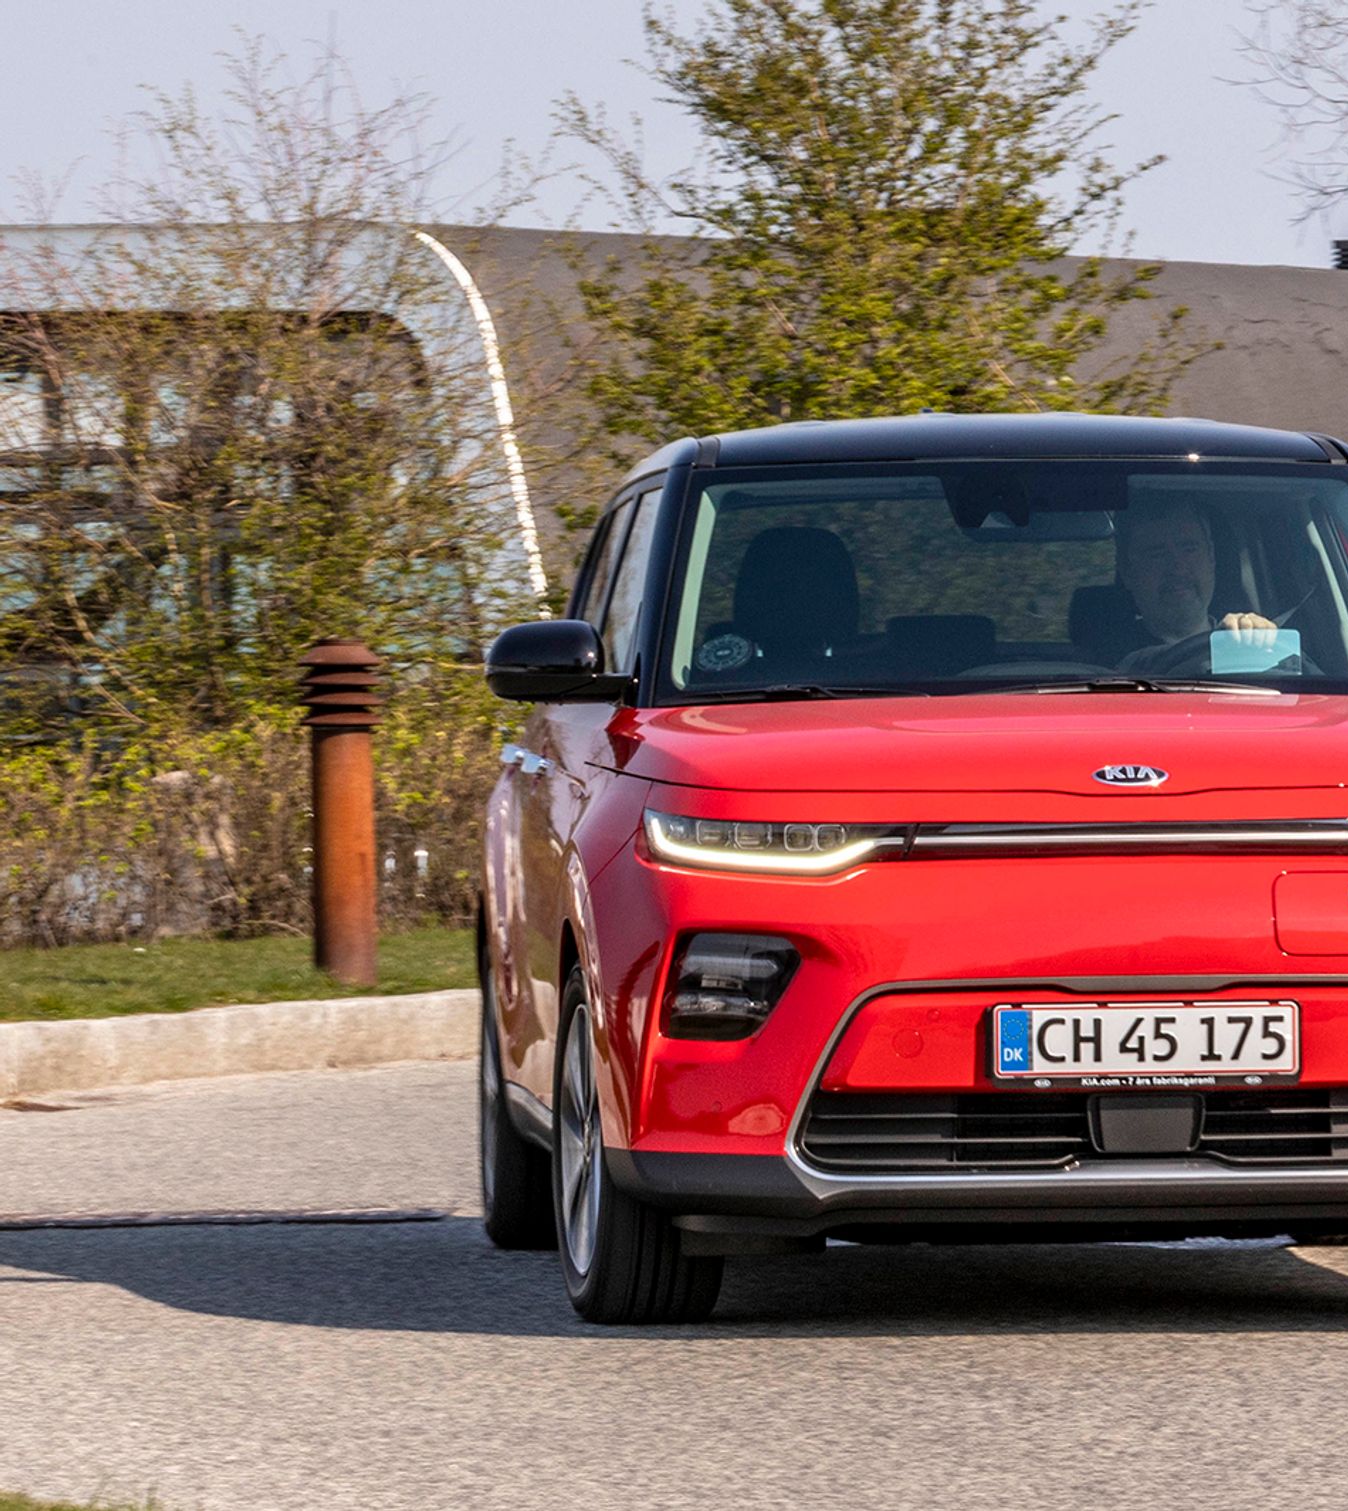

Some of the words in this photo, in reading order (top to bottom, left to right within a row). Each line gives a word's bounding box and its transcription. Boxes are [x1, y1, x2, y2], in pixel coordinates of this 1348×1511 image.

[1104, 765, 1158, 779] KIA
[1036, 1018, 1103, 1063] CH
[1118, 1016, 1178, 1063] 45
[1200, 1015, 1286, 1061] 175
[1003, 1047, 1024, 1062] DK
